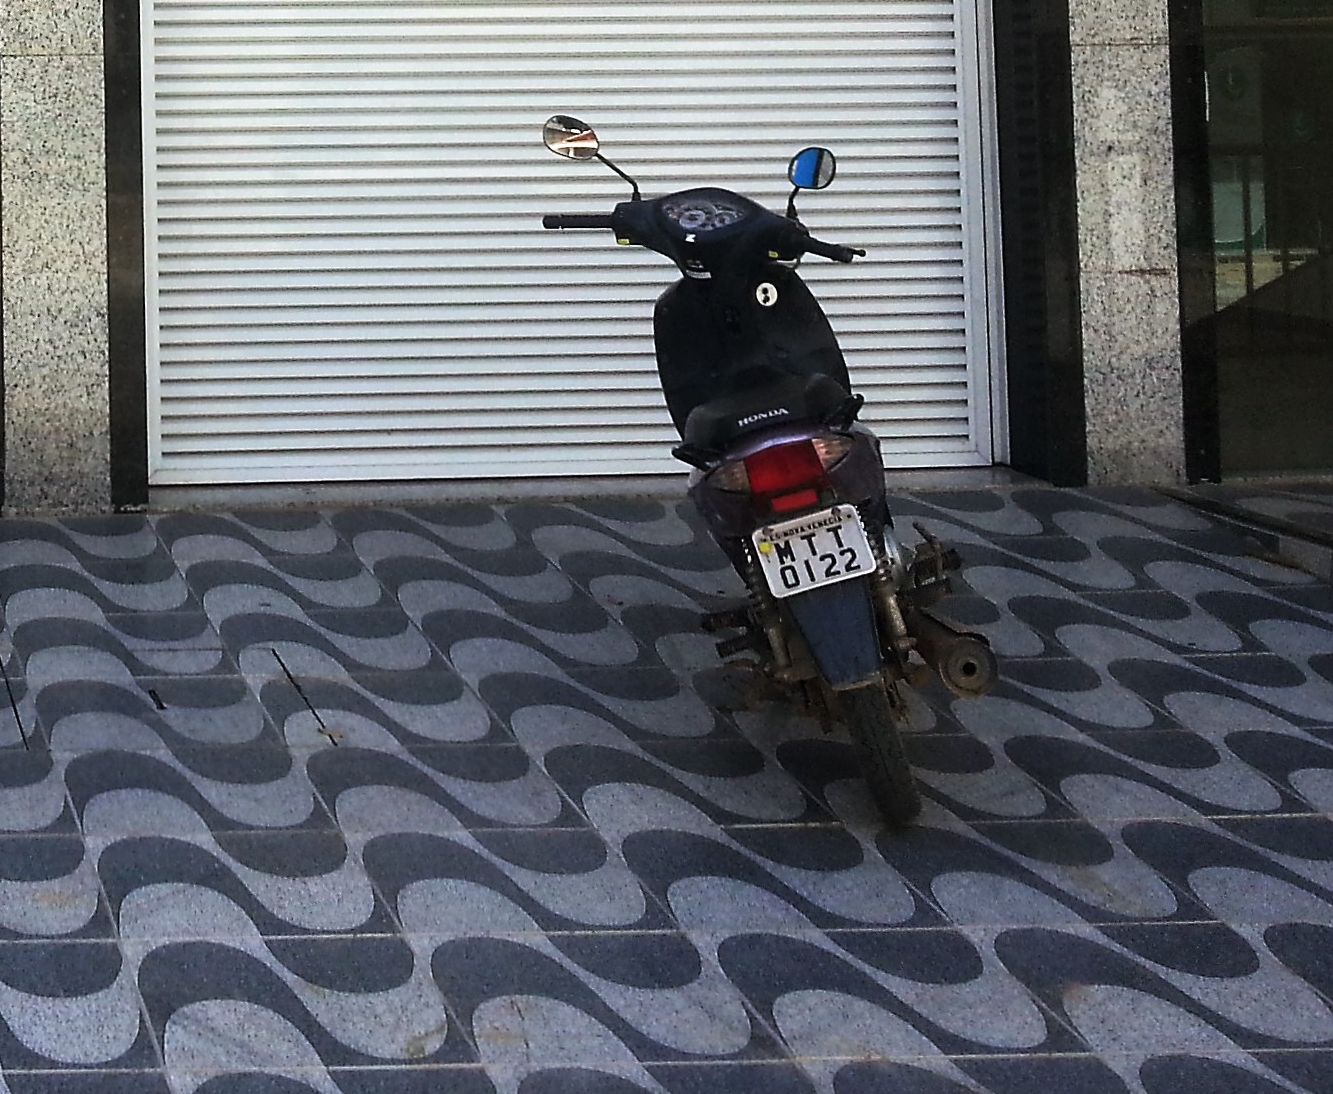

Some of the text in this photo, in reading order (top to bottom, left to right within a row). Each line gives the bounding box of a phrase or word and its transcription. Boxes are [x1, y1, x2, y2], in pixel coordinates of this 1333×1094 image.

[738, 408, 789, 427] HONDA
[774, 524, 844, 565] MTT
[779, 547, 861, 589] 0122
